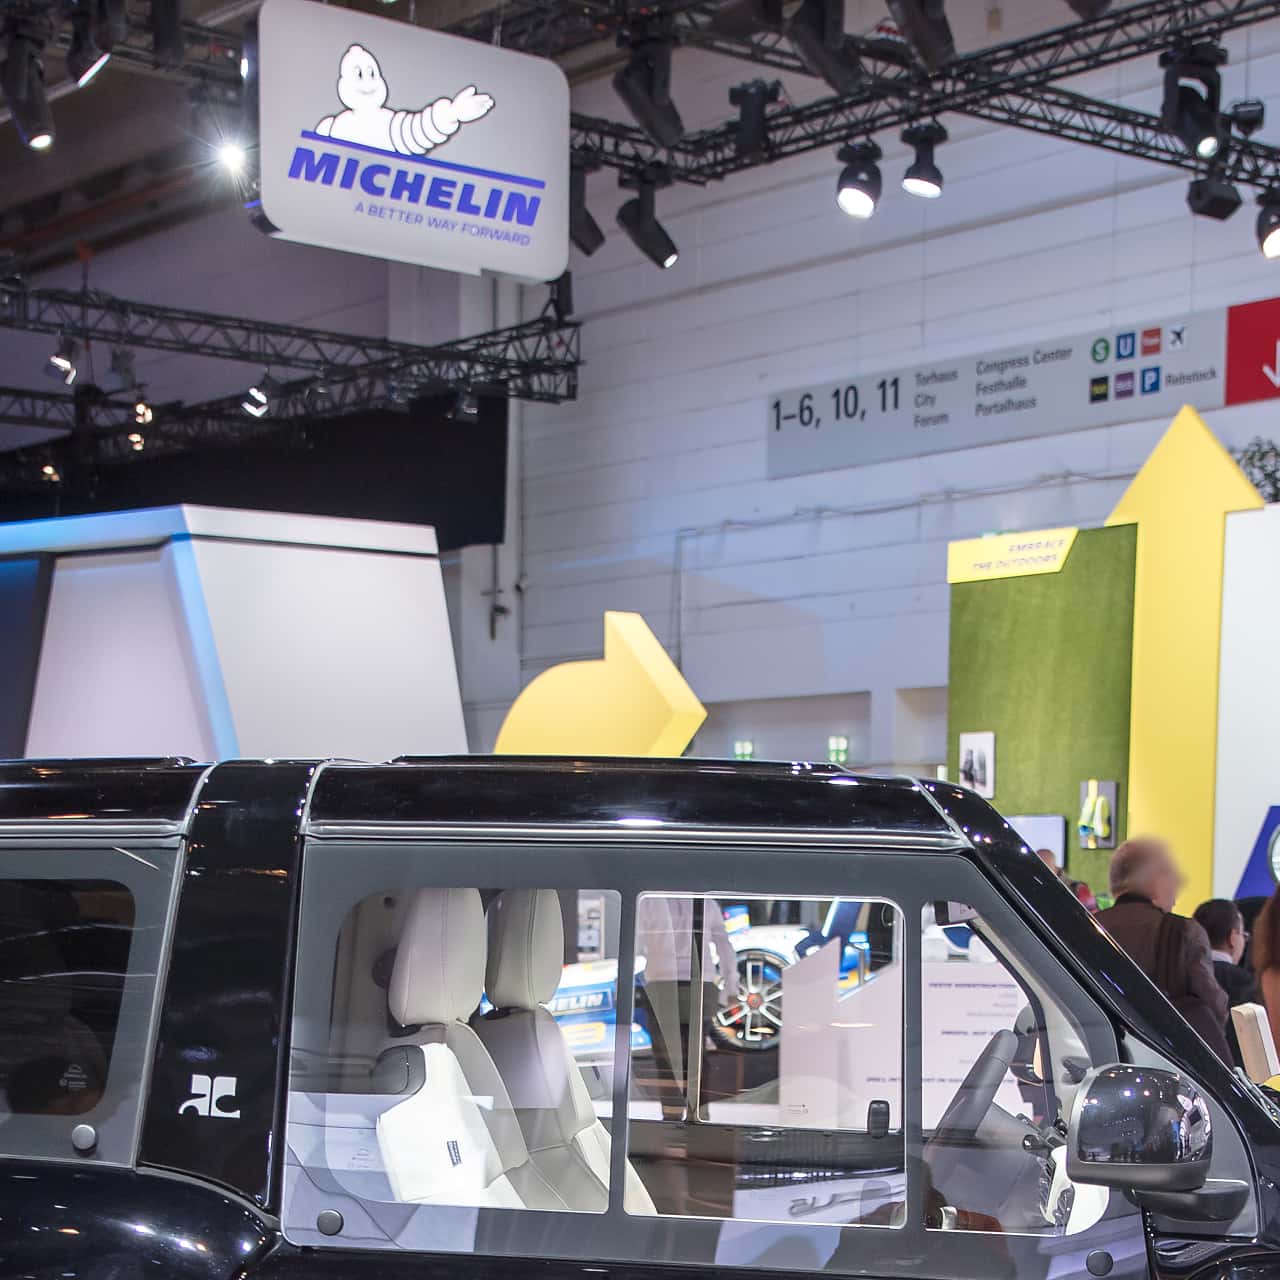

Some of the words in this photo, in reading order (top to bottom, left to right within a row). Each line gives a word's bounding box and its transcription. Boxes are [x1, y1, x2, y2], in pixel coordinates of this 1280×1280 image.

[287, 146, 542, 227] MICHELIN
[355, 201, 365, 213] A
[367, 204, 424, 225] BETTER
[427, 216, 458, 232] WAY
[461, 222, 531, 247] FORWARD
[975, 355, 1031, 377] Congress
[1032, 347, 1073, 366] Center
[975, 376, 1027, 397] Festhalle
[832, 385, 867, 422] 10,
[877, 377, 899, 412] 11
[913, 392, 937, 409] City
[975, 397, 1038, 417] Portalhaus
[913, 412, 950, 429] Forum
